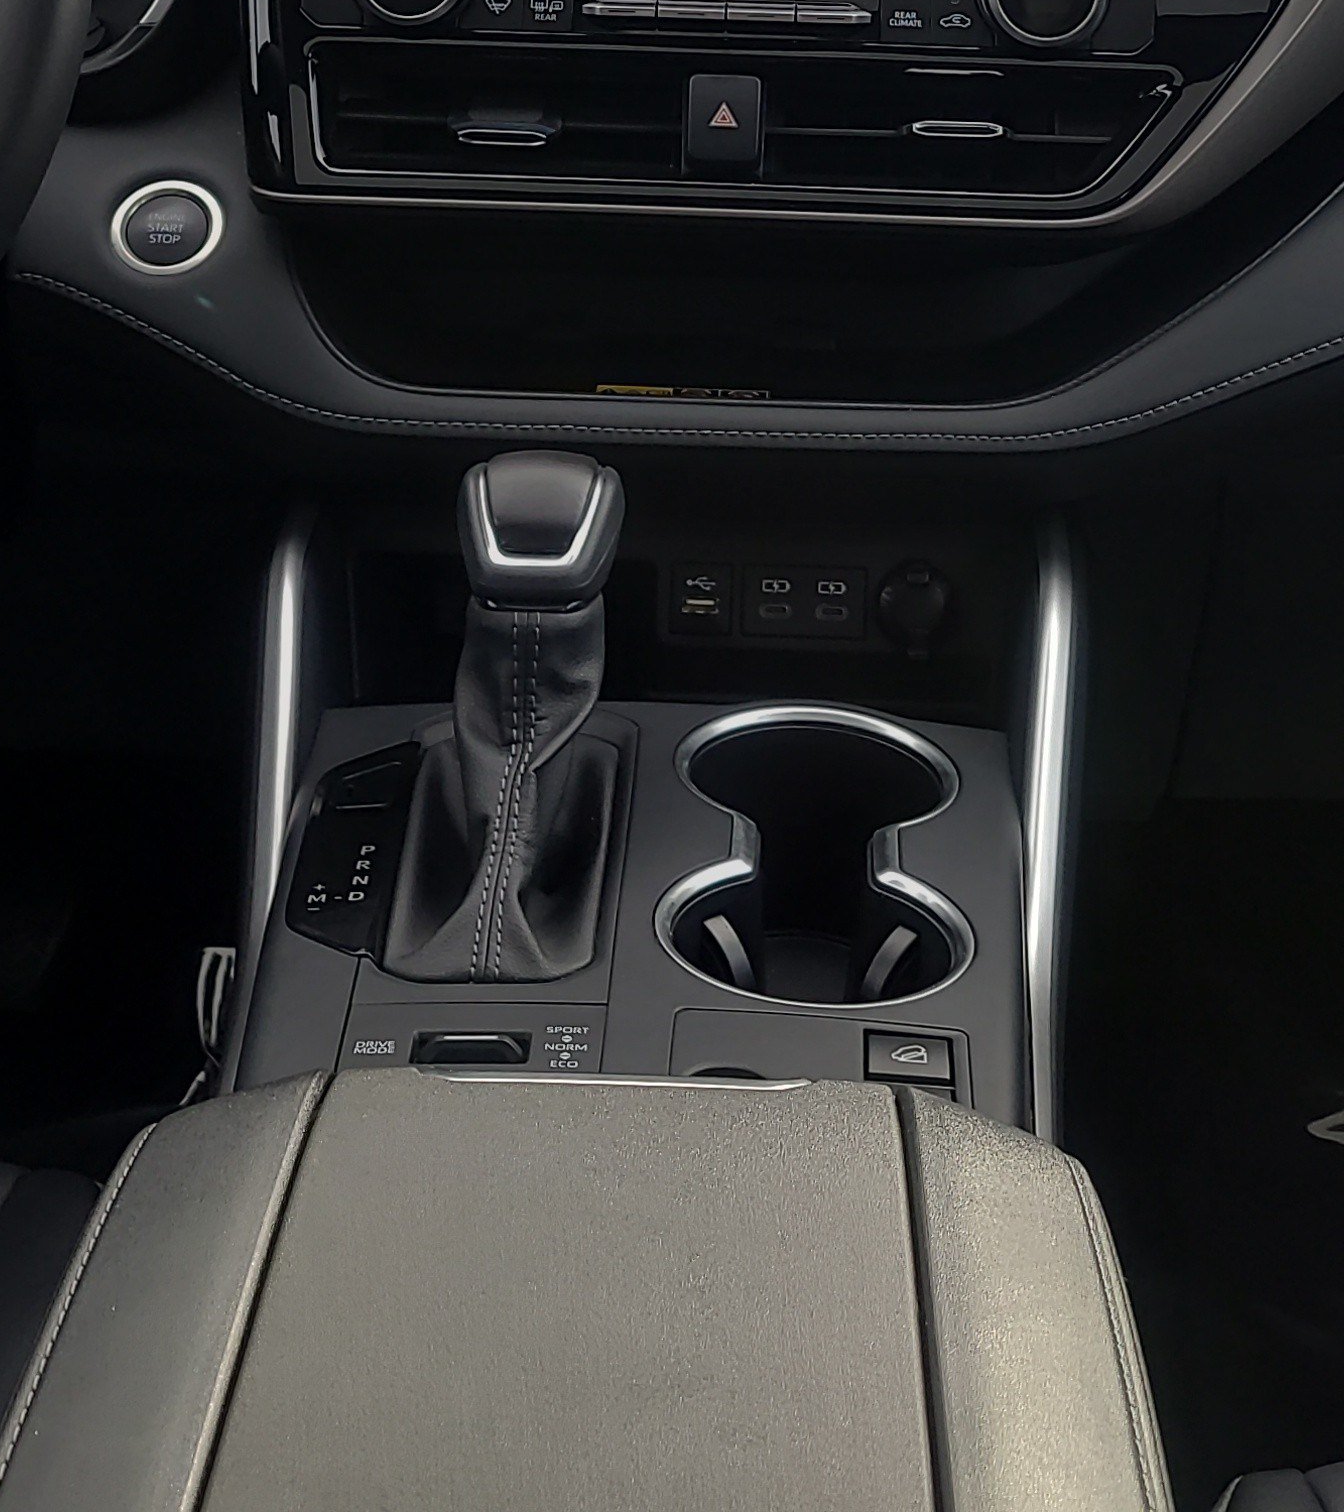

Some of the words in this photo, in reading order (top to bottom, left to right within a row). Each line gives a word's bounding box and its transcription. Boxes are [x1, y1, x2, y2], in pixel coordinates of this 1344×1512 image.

[534, 13, 557, 22] REAR
[894, 11, 917, 20] REAR
[889, 19, 923, 28] CLIMATE
[147, 223, 184, 233] START
[149, 234, 182, 244] STOP
[360, 845, 376, 856] P
[355, 860, 371, 870] R
[351, 875, 370, 885] N
[307, 893, 327, 904] M
[348, 891, 365, 902] D
[546, 1026, 590, 1034] SPORT
[355, 1040, 396, 1048] DRIVE
[544, 1042, 588, 1051] NORM
[549, 1059, 579, 1068] ECO
